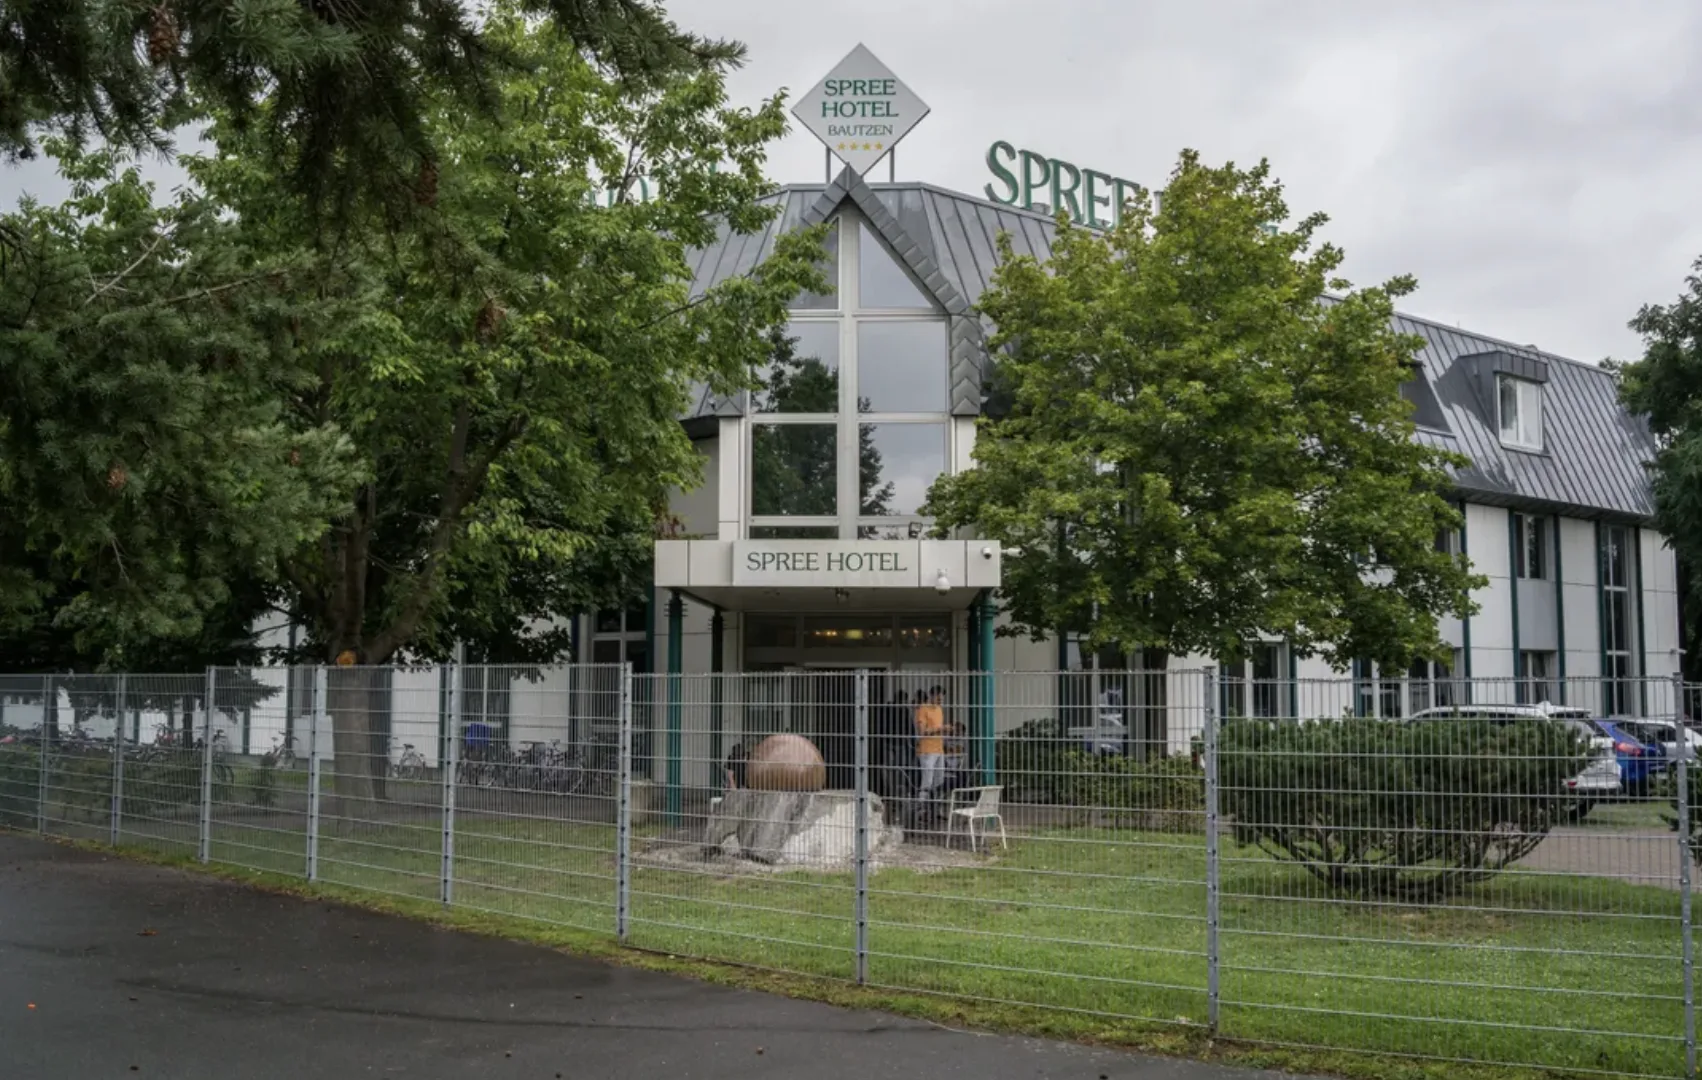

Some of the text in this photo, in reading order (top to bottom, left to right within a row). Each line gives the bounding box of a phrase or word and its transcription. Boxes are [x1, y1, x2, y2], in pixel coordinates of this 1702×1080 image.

[824, 79, 897, 97] SPREE
[821, 101, 899, 118] HOTEL
[827, 124, 894, 136] BAUTZEN
[747, 551, 908, 571] SPREE HOTEL
